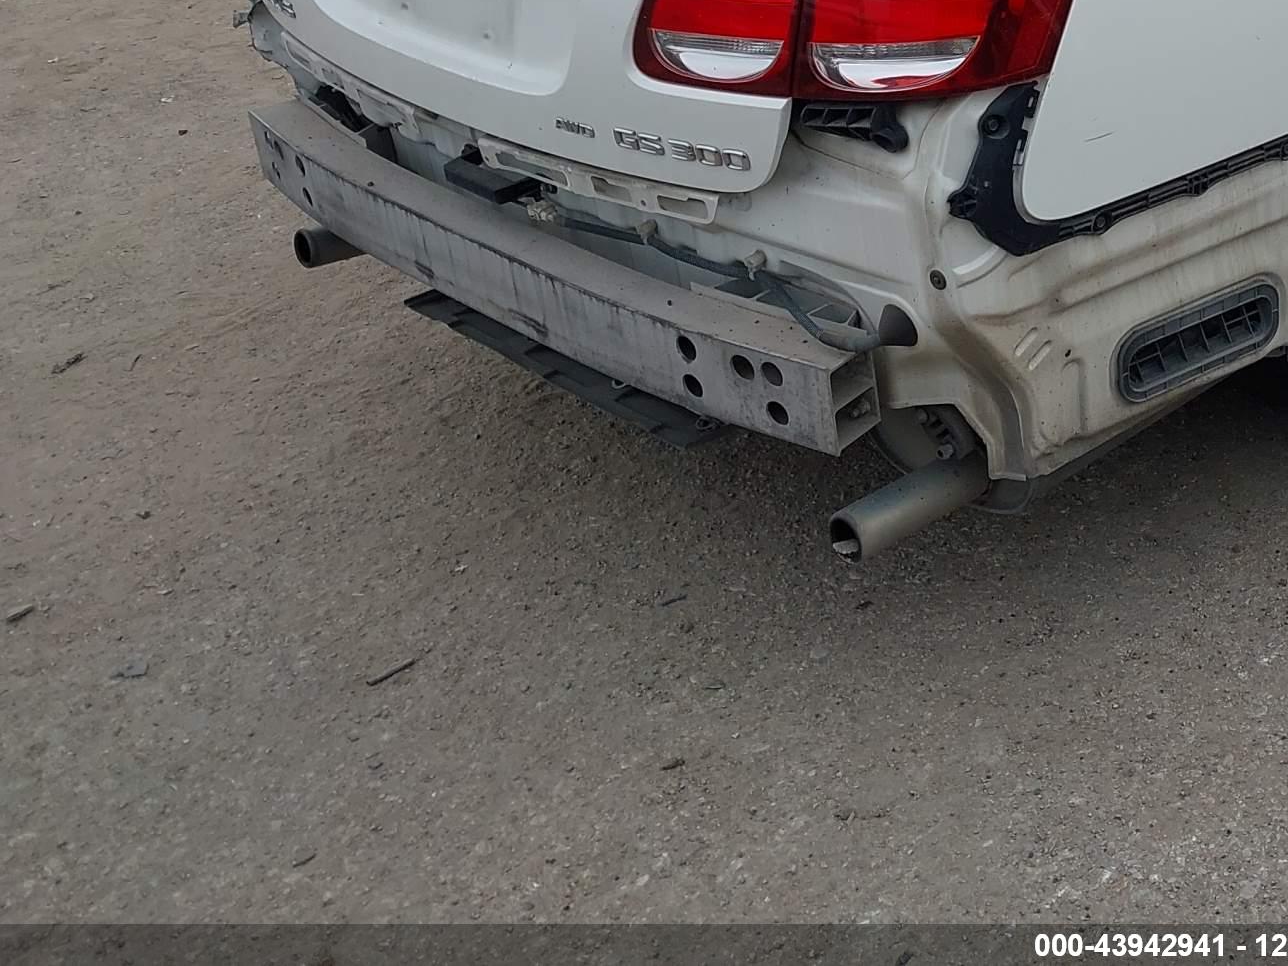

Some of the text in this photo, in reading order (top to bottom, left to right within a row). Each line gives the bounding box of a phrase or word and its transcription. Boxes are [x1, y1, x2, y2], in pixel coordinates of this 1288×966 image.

[555, 116, 595, 139] AWD
[613, 127, 752, 172] GS 300
